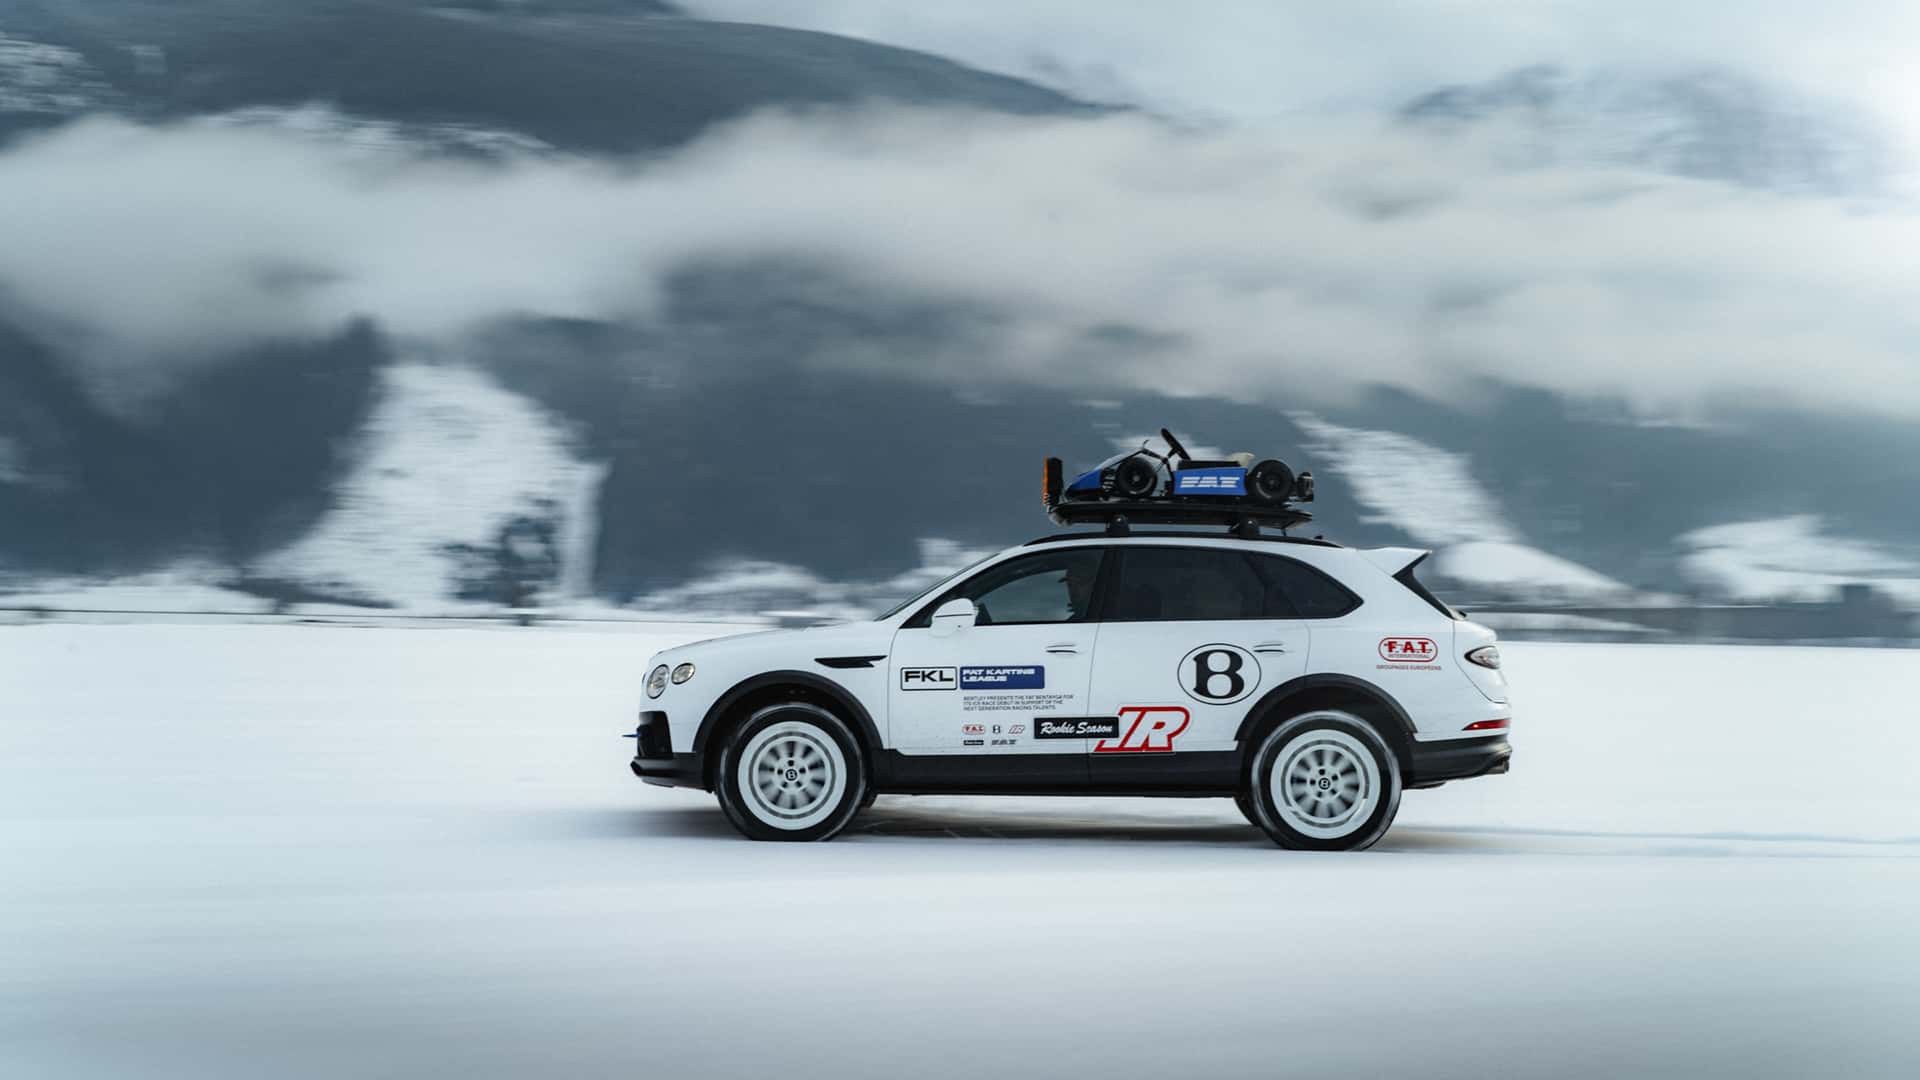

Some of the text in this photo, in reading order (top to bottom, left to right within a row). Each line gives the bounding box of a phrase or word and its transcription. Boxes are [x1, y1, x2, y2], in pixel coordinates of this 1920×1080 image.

[905, 670, 954, 682] FKL
[1040, 721, 1113, 735] Rookie Season
